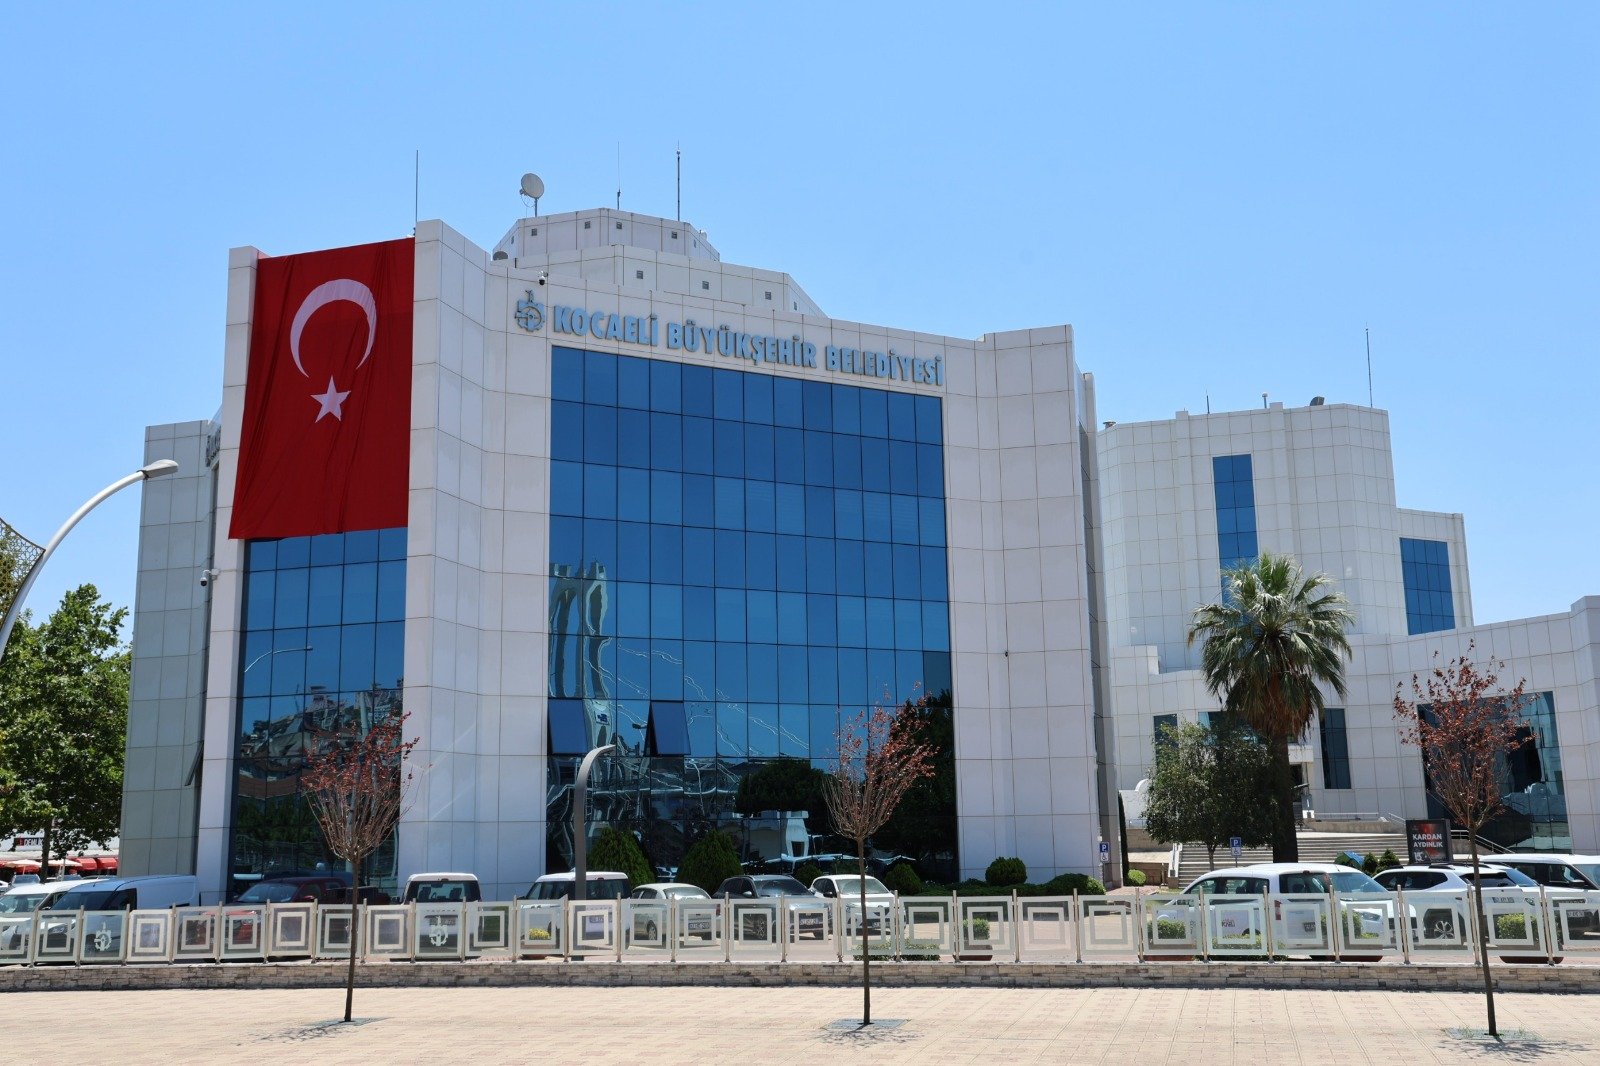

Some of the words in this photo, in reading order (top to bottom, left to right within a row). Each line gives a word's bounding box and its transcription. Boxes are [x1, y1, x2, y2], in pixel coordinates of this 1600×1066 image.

[554, 305, 658, 346] KOCAELİ
[667, 319, 817, 368] BÜYÜKŞEHİR
[825, 344, 944, 386] BELEDİYESİ
[1233, 839, 1239, 847] P
[1101, 844, 1107, 852] P
